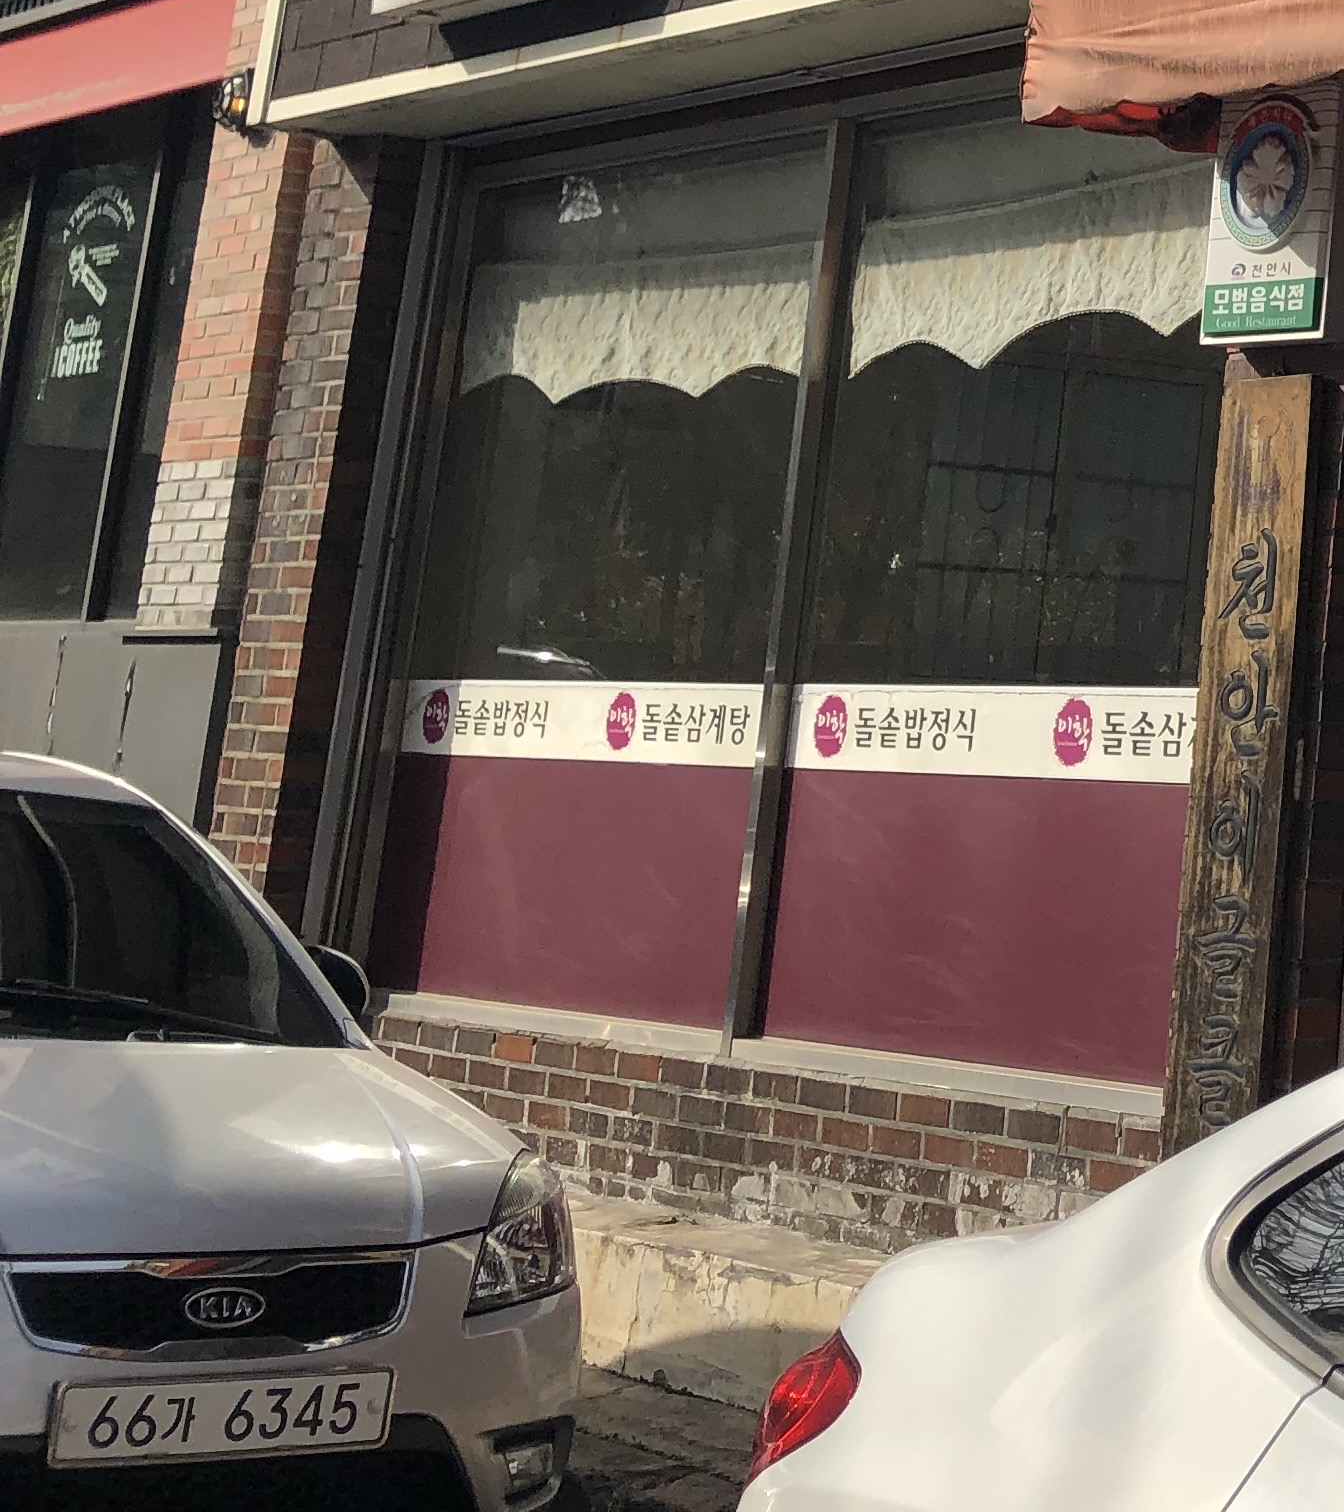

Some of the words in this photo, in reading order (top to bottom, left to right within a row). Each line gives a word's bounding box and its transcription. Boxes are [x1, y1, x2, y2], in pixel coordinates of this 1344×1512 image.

[1251, 261, 1292, 278] 천안시
[1212, 283, 1305, 315] 모범음식점
[1216, 317, 1241, 329] Good
[1246, 315, 1297, 328] Restaurant
[454, 699, 551, 739] 돌솥밥정식
[641, 702, 752, 746] 돌솥삼계탕
[853, 706, 978, 752] 돌솥밥정식
[199, 1292, 254, 1320] KIA
[87, 1393, 196, 1450] 66가
[223, 1381, 363, 1443] 6345
